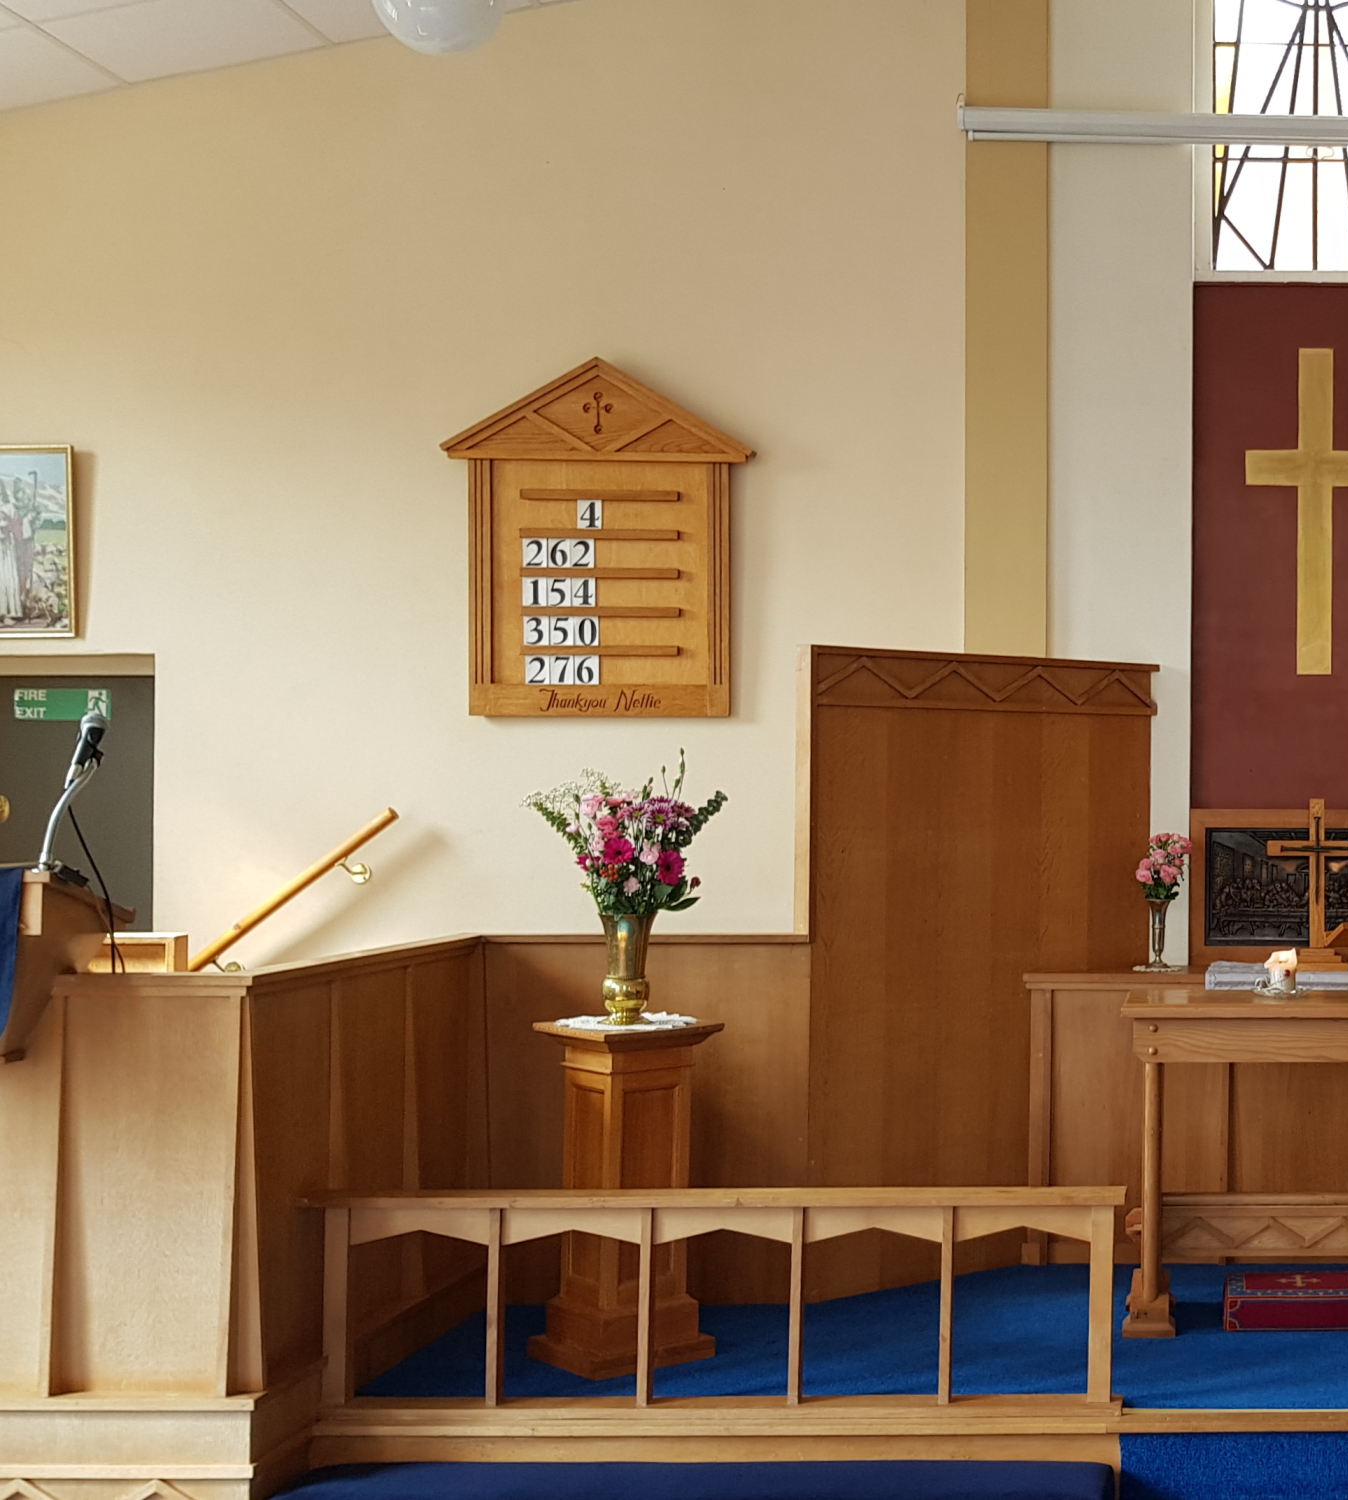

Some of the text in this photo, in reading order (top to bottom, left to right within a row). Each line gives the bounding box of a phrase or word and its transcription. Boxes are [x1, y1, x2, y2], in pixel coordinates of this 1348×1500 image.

[580, 501, 600, 529] 4
[525, 539, 592, 567] 262
[528, 578, 594, 606] 154
[525, 617, 597, 646] 350
[528, 656, 595, 684] 276
[15, 689, 47, 701] FIRE
[539, 688, 661, 712] Thankyou Nellie
[15, 707, 46, 718] EXIT
